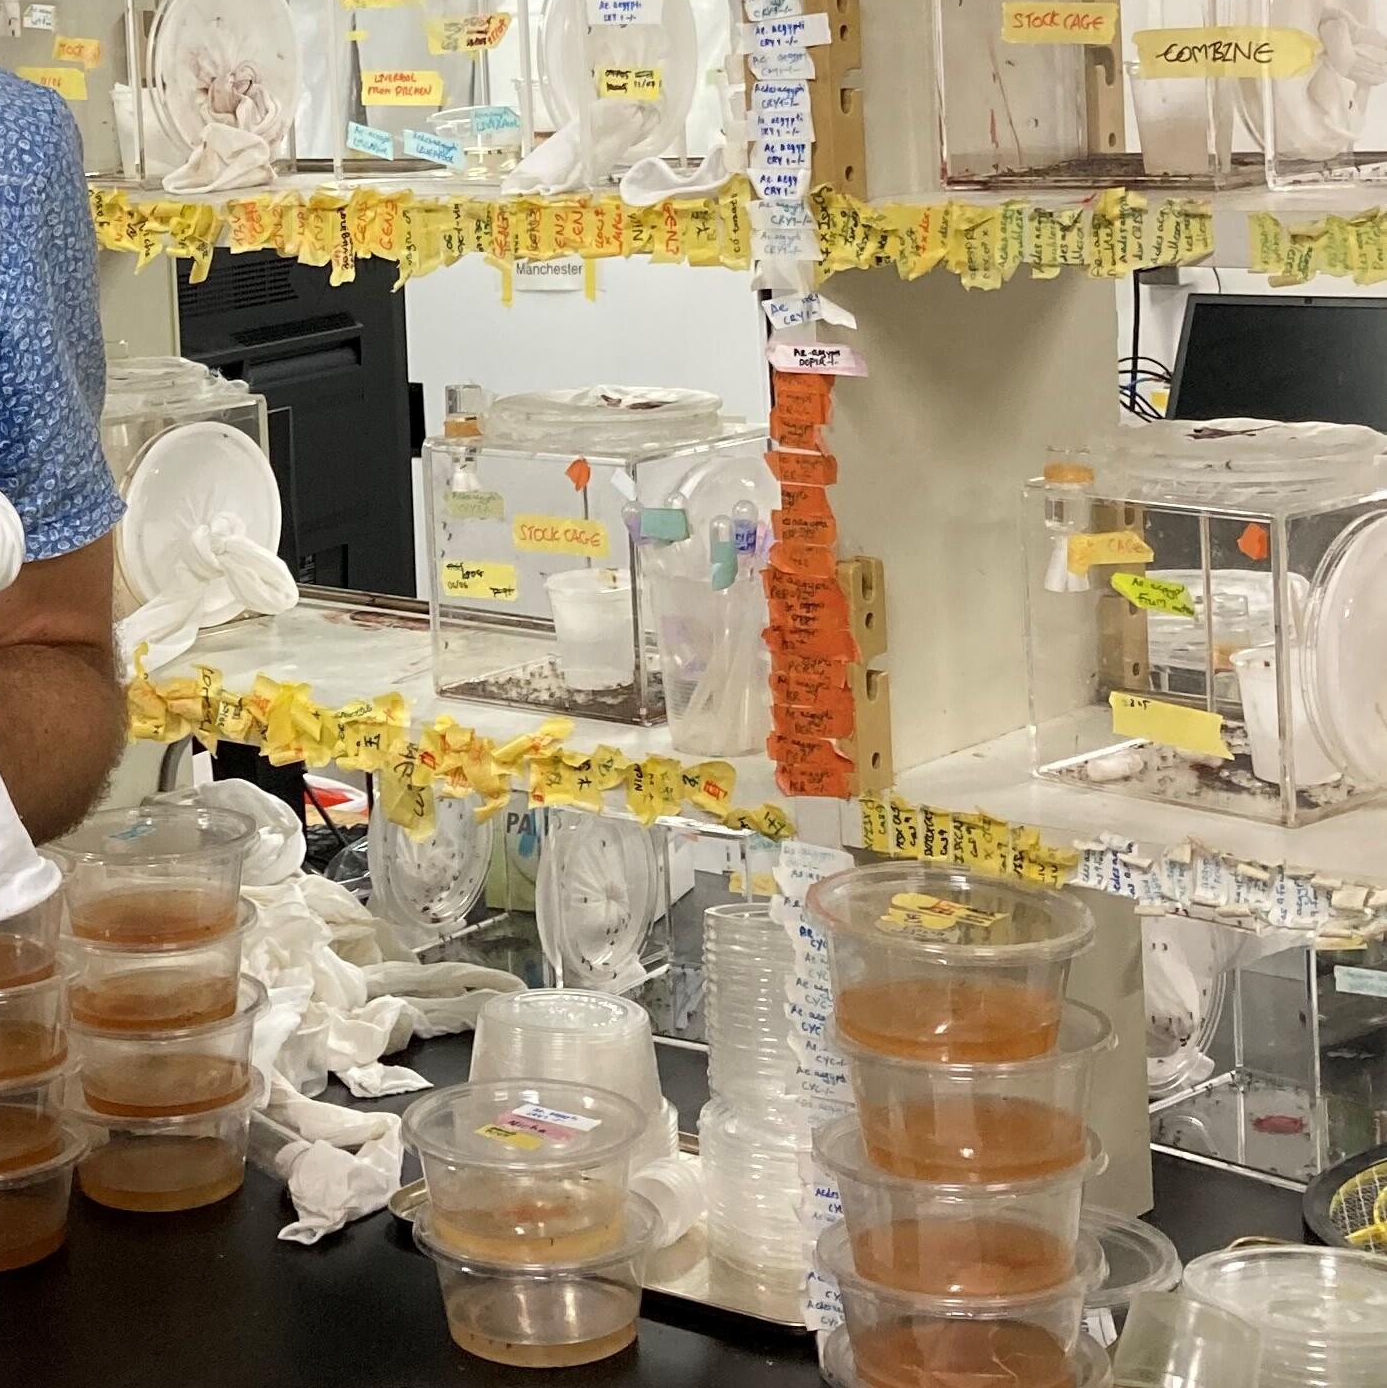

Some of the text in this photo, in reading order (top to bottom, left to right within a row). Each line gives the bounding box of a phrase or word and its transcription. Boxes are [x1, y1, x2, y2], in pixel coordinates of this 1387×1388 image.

[1012, 12, 1105, 31] STOCK CAGE
[516, 262, 582, 276] Manchester
[519, 524, 560, 542] STOCK
